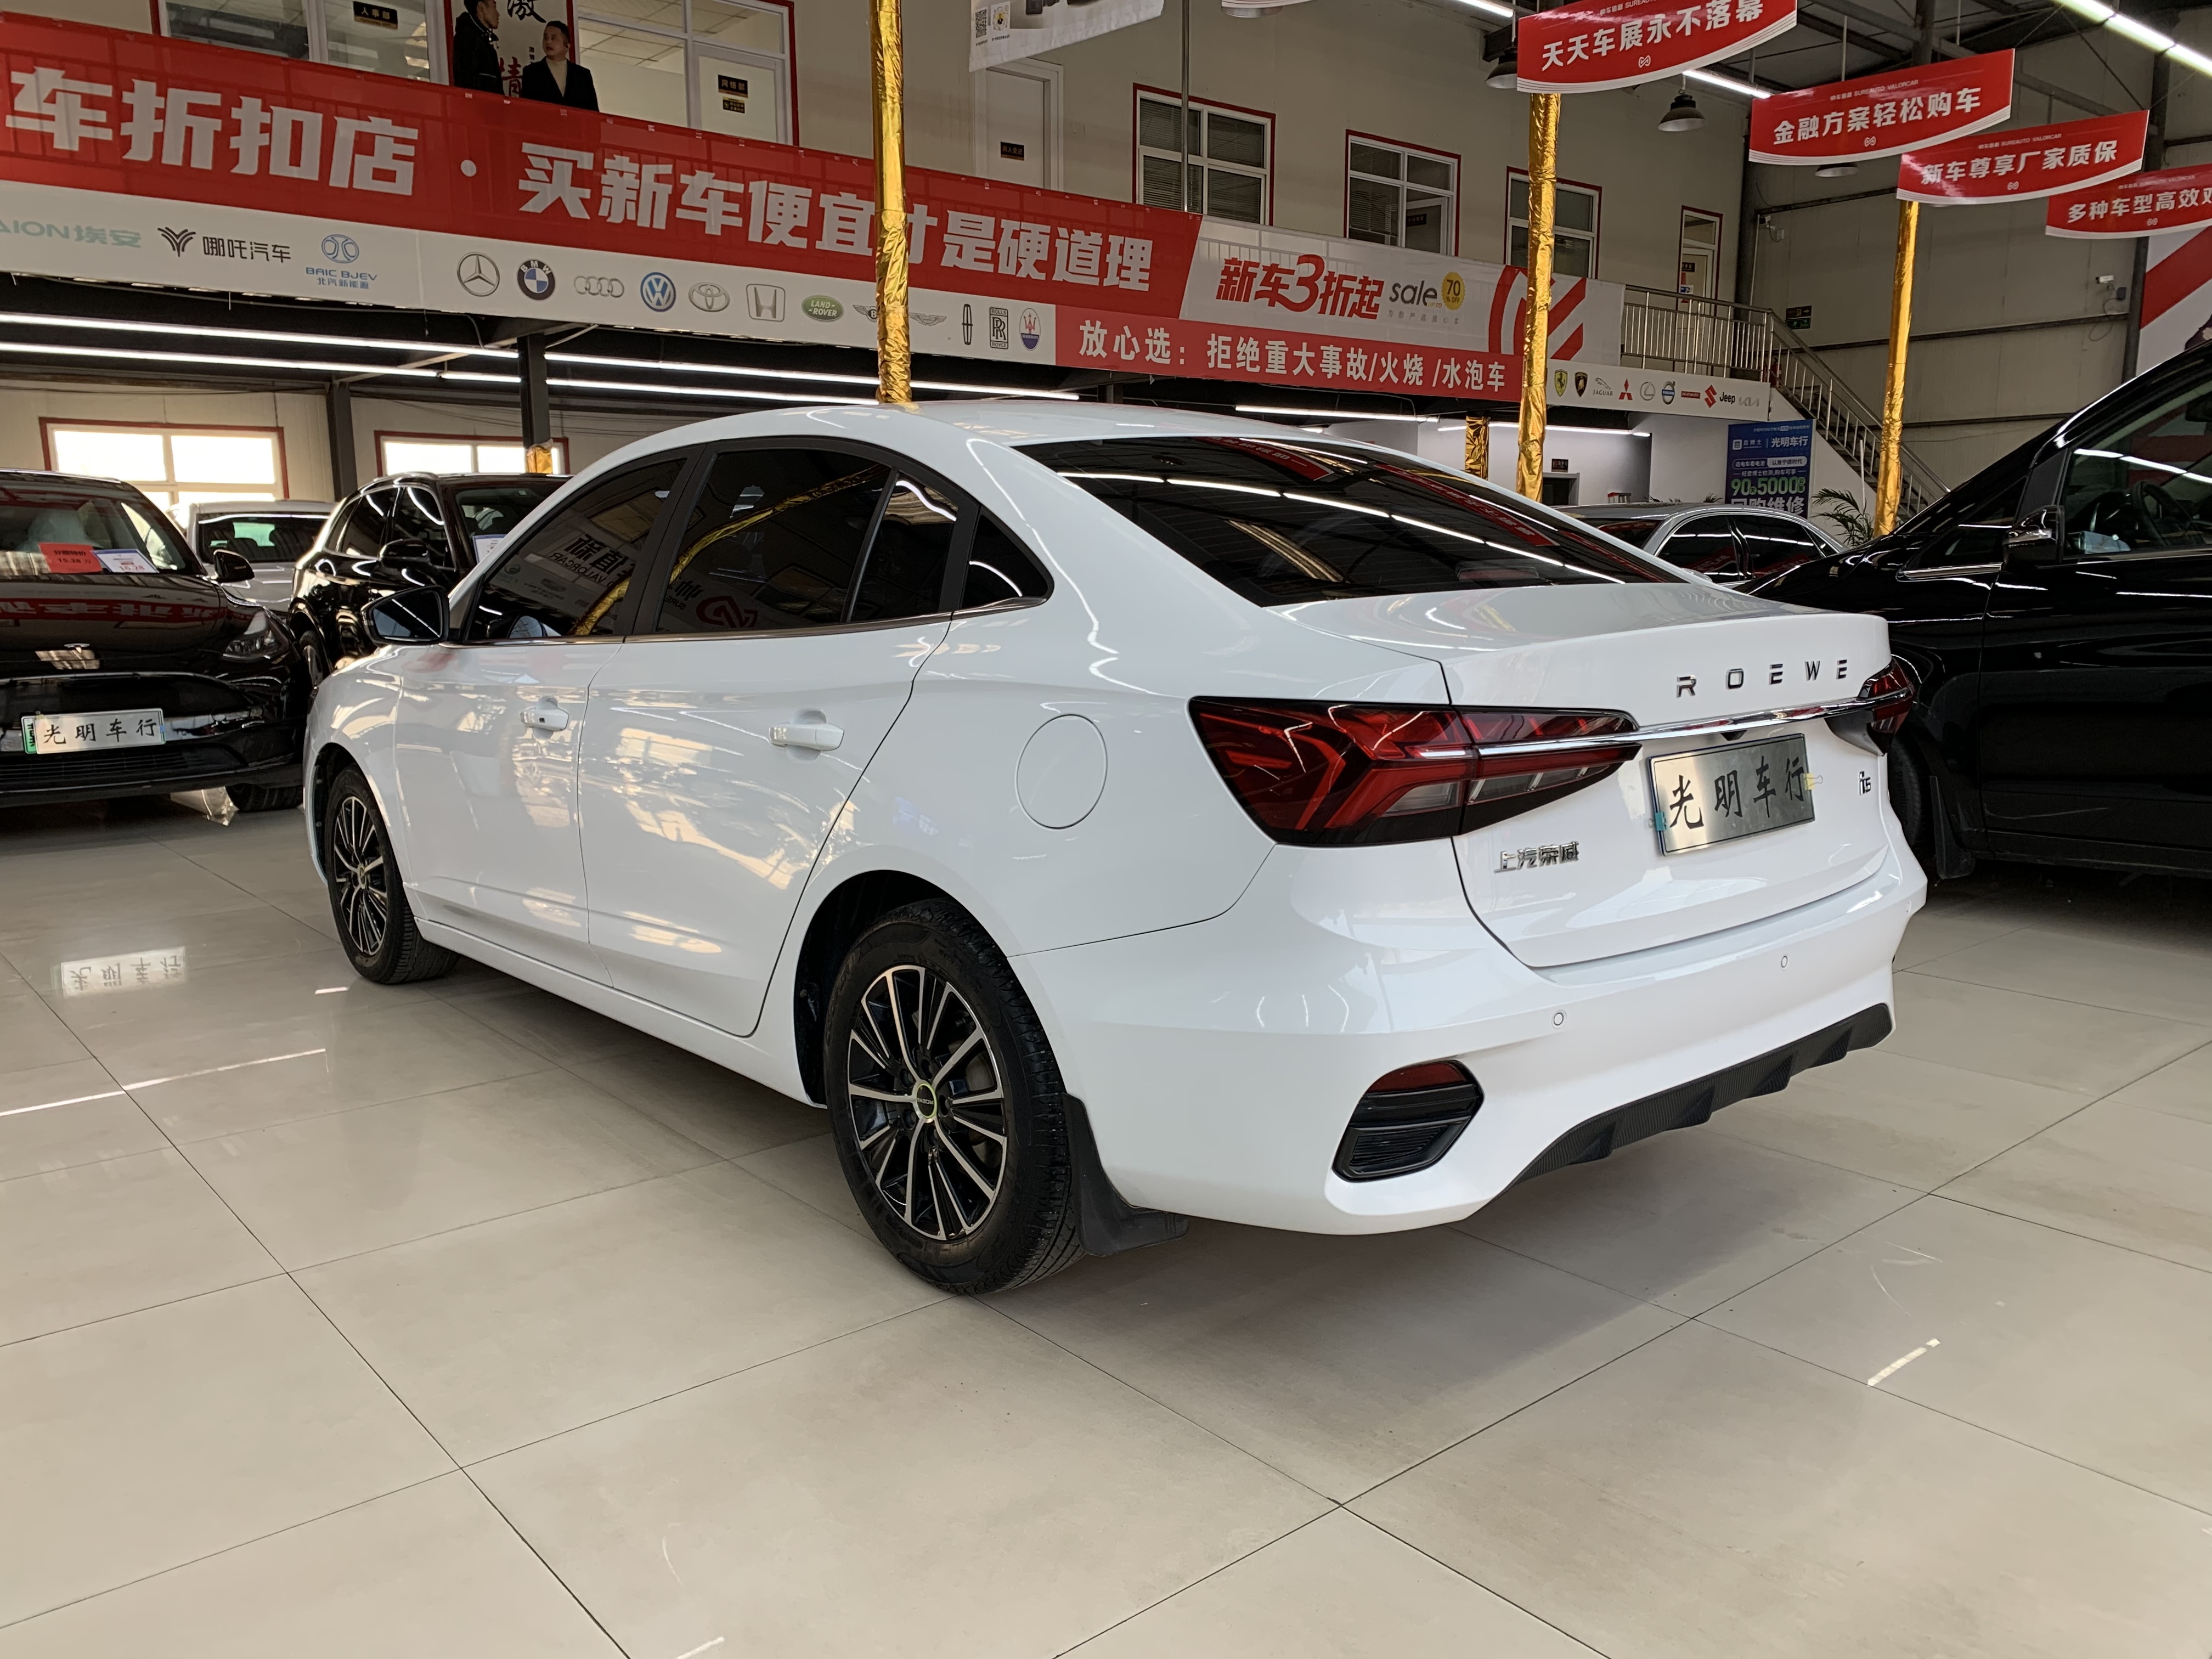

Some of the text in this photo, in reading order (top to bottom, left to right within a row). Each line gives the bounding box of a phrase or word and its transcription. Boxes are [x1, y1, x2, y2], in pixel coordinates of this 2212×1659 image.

[1542, 0, 1764, 71] 天天车展永不落幕
[1854, 85, 1885, 97] SUREAUTO
[1887, 79, 1918, 91] VALORCAR
[1774, 87, 1982, 145] 金融方案轻松购车
[2001, 137, 2030, 146] SUREAUTO
[2032, 133, 2062, 142] VALORCAR
[1921, 140, 2118, 185] 新车尊享厂家质保
[74, 224, 142, 248] 埃安
[202, 236, 291, 263] 哪吒汽车
[306, 267, 377, 281] BAIC BJEV
[1216, 254, 1385, 319] 新车3折起
[1389, 280, 1437, 306] sale
[1446, 279, 1461, 296] 70
[811, 300, 831, 309] LAND
[812, 308, 837, 317] ROVER
[1719, 392, 1736, 404] Jeep
[1771, 436, 1808, 448] 光明车行
[1676, 659, 1848, 698] ROEWE
[44, 718, 157, 745] 光明车行
[1669, 754, 1805, 831] 光明车行
[1494, 840, 1580, 873] 上汽荣威
